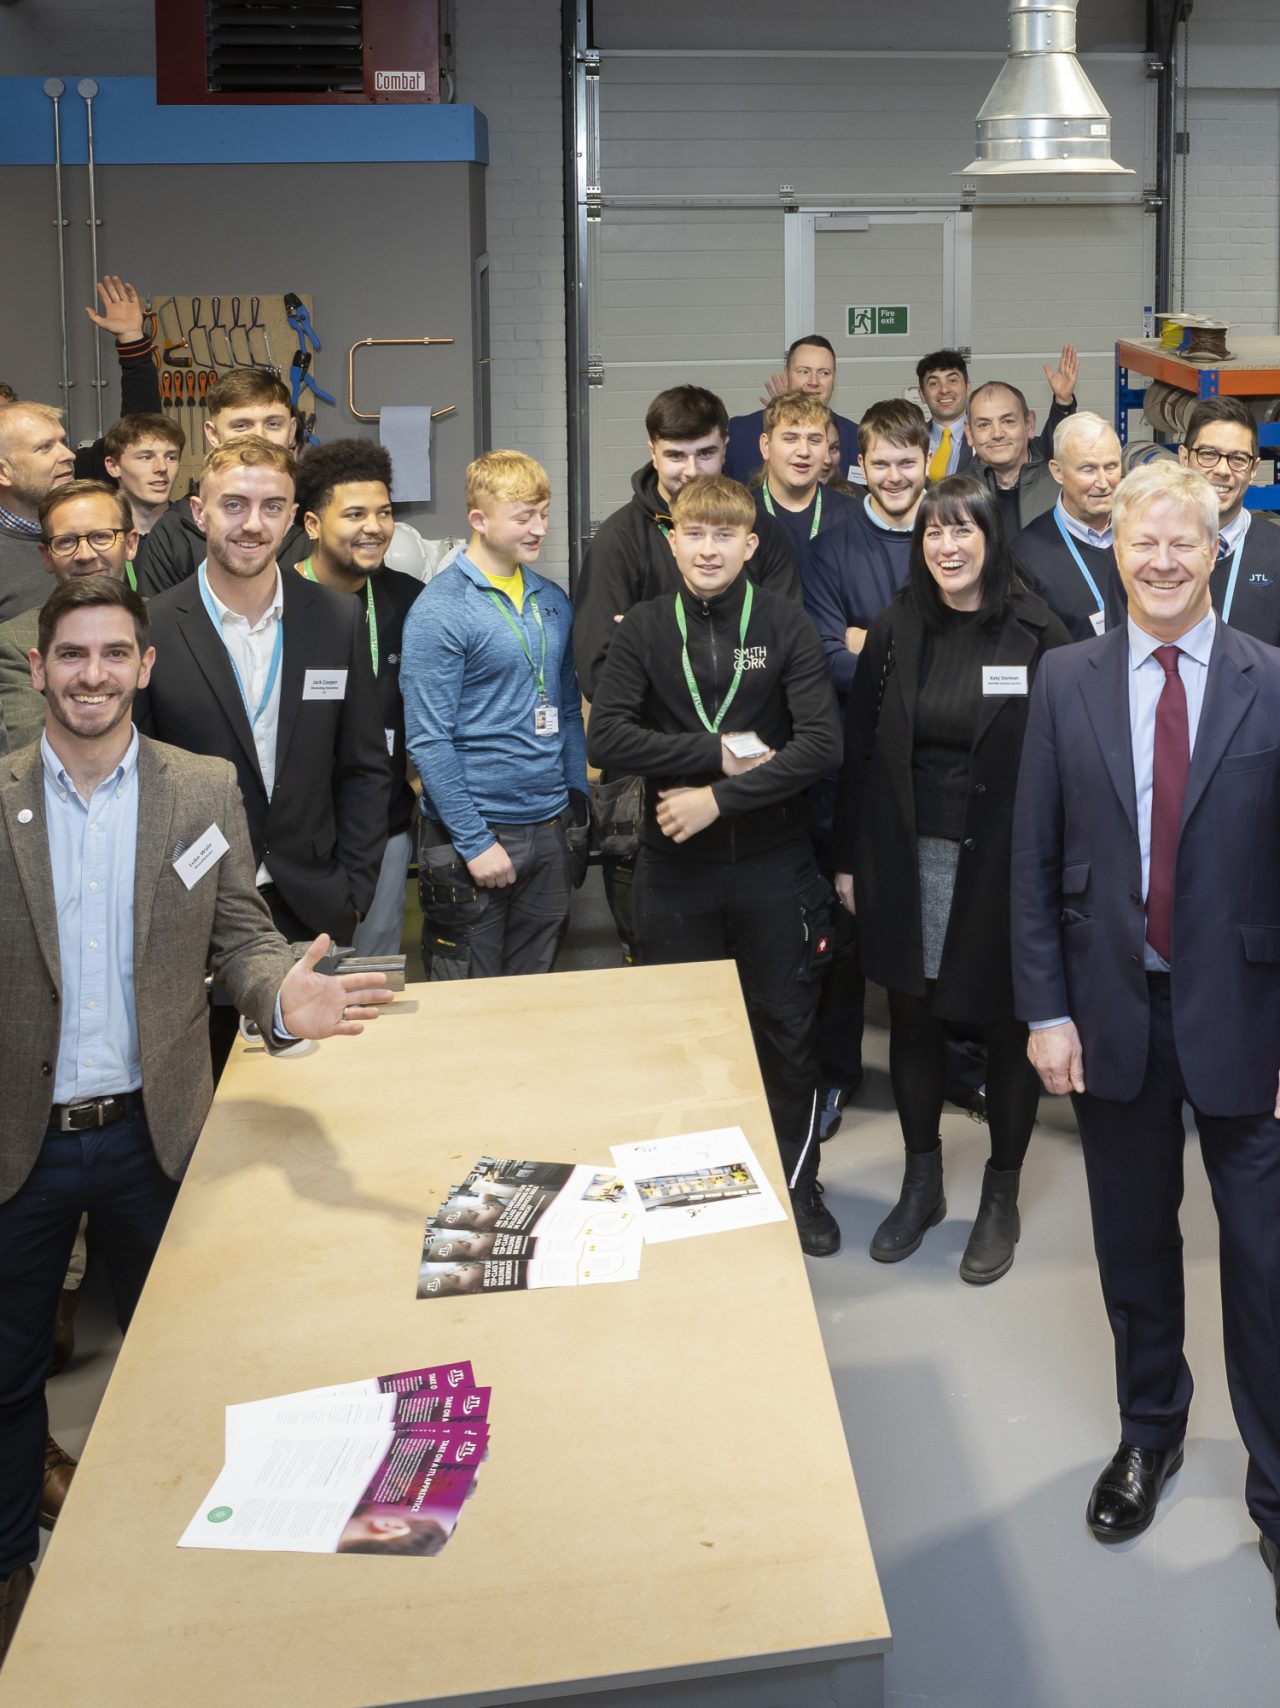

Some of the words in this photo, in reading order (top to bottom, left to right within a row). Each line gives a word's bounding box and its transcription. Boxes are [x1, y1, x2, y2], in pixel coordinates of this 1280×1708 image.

[376, 72, 421, 90] Combat
[1249, 574, 1268, 582] JTL
[429, 1373, 437, 1385] TAKE
[444, 1396, 453, 1409] TAKE
[440, 1440, 450, 1453] TAKE
[411, 1478, 432, 1512] APPRENTICE
